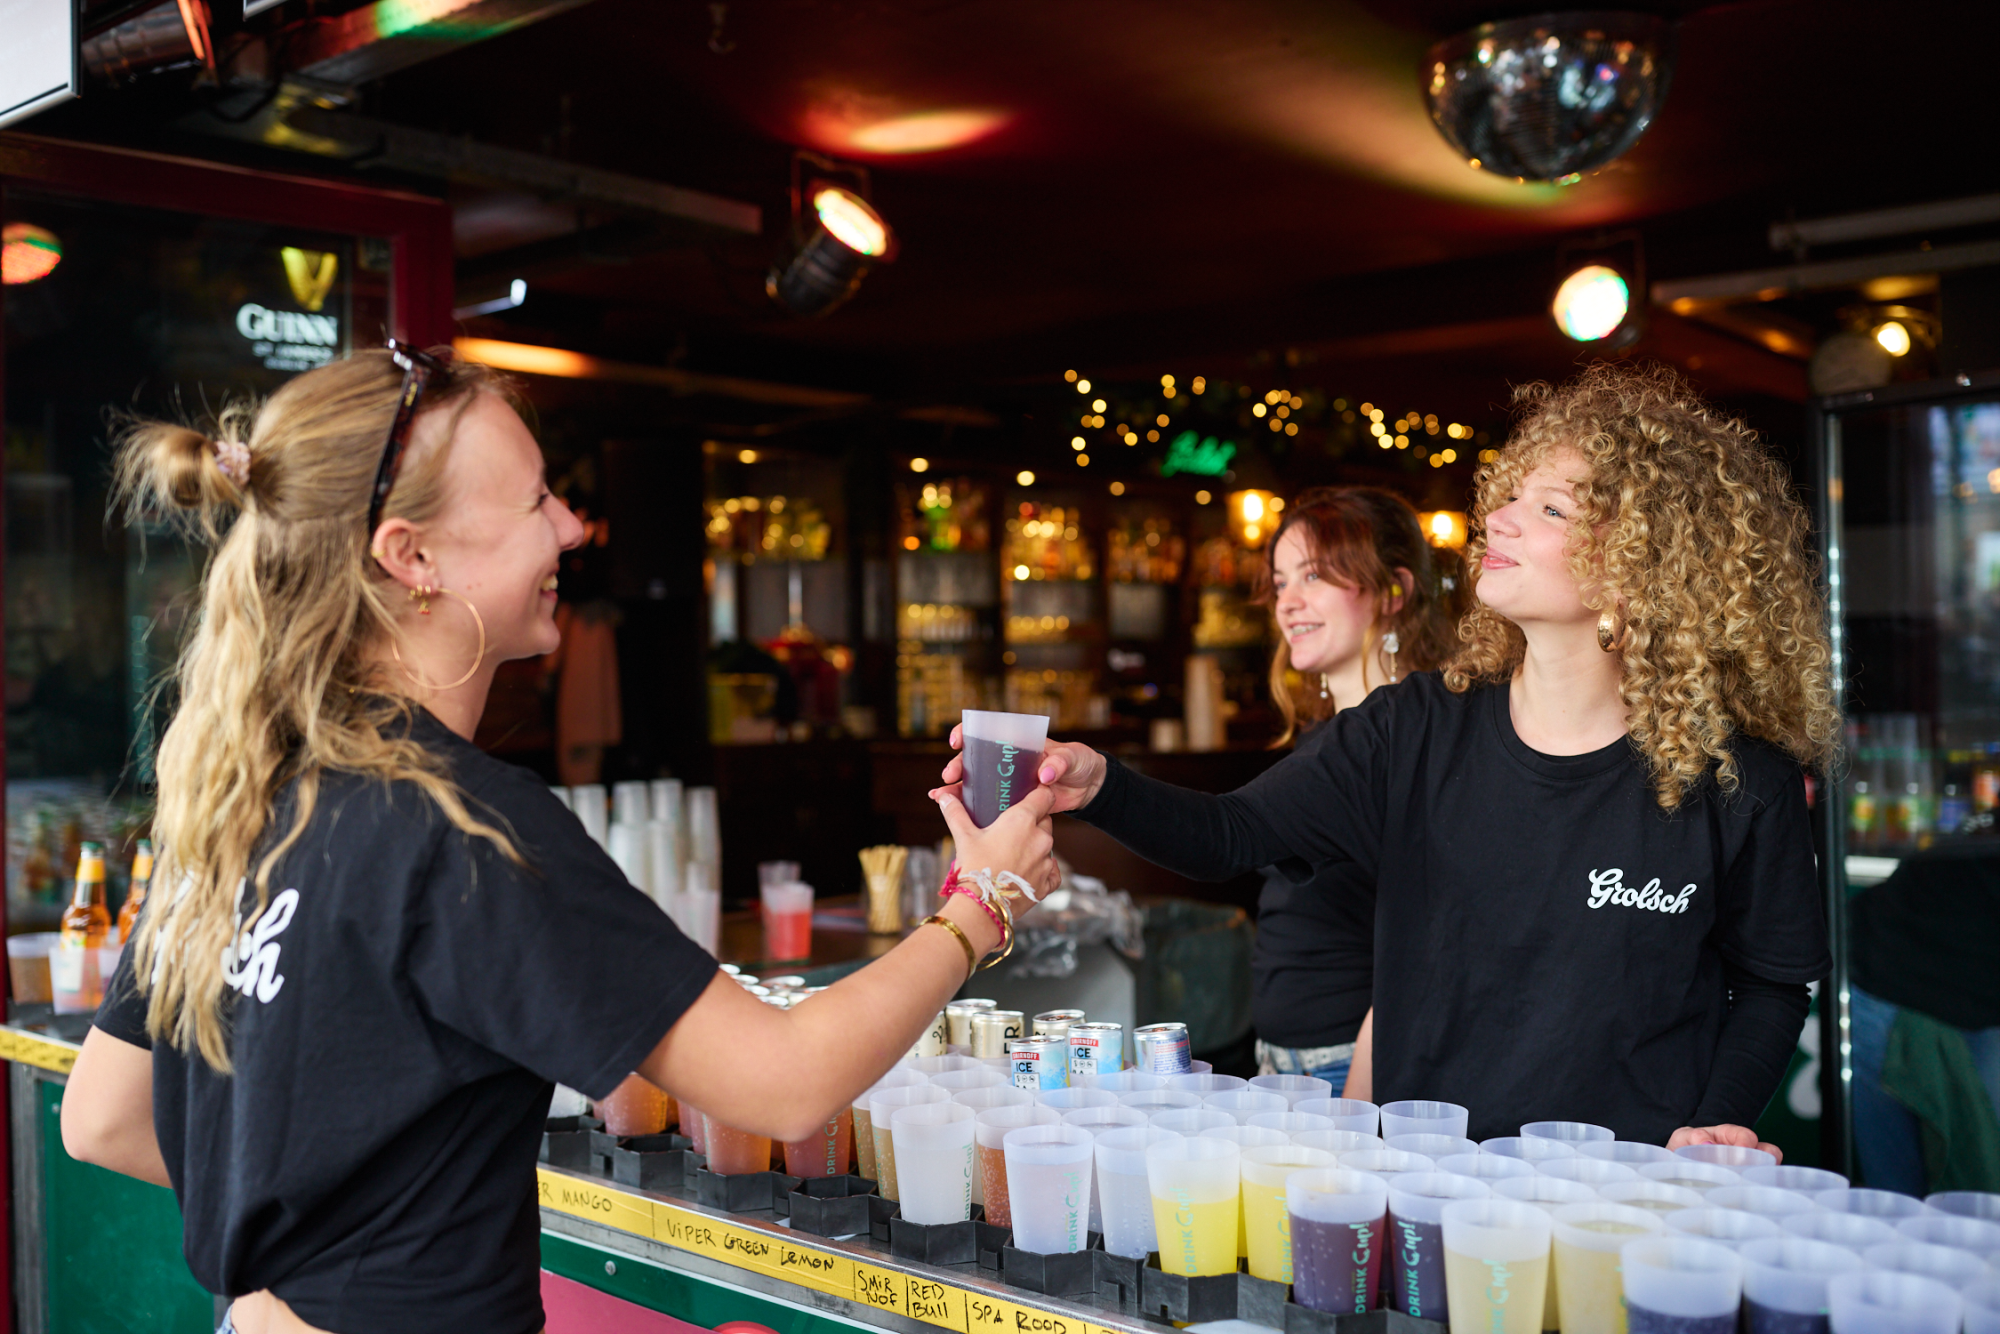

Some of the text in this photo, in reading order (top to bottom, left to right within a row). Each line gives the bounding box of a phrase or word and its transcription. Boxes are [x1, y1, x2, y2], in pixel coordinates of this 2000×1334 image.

[995, 740, 1020, 811] RINK Cup!
[1587, 868, 1698, 914] Grolsch
[1015, 1062, 1033, 1072] ICE
[1074, 1048, 1091, 1058] ICE
[826, 1139, 837, 1175] DRINK
[562, 1189, 612, 1212] MANGO
[1063, 1171, 1083, 1252] DRINK Cup!
[724, 1233, 770, 1256] GREEN
[1169, 1187, 1198, 1273] DRINK Cup!
[1349, 1222, 1374, 1314] DRINK Cup!
[1397, 1220, 1423, 1317] DRINK Cup!
[1482, 1258, 1514, 1305] Cup!
[911, 1280, 945, 1300] RED
[972, 1301, 1067, 1334] SPA ROOD
